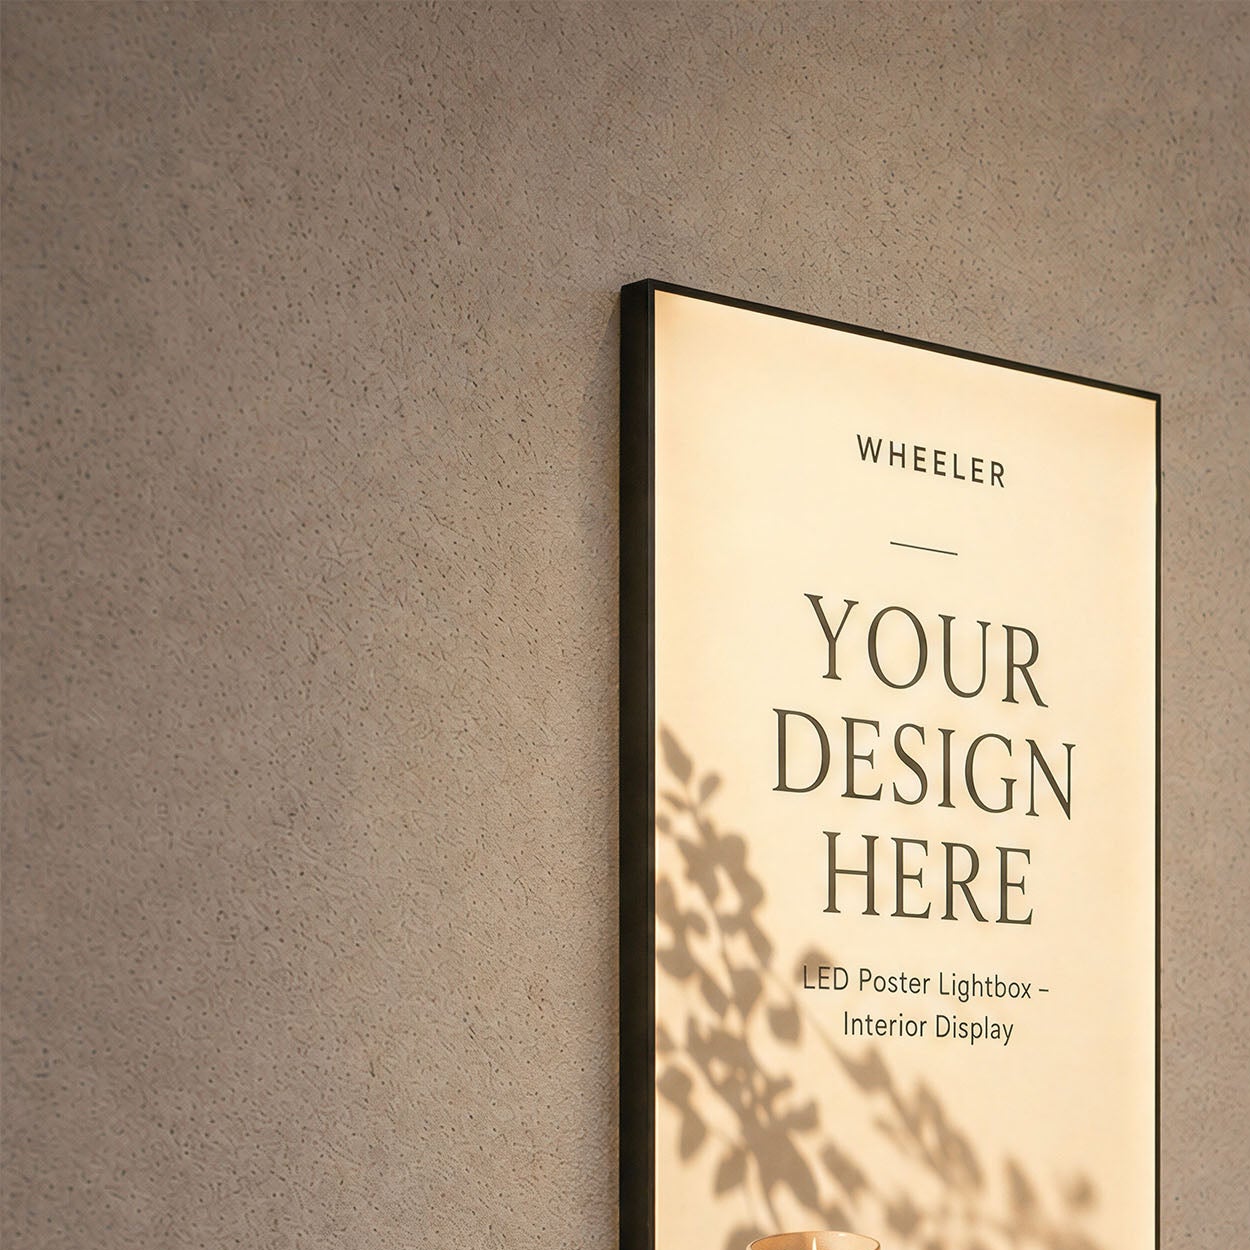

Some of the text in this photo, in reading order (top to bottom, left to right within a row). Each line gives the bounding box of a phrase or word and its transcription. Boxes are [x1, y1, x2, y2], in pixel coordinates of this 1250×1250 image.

[856, 434, 1007, 488] WHEELER
[804, 593, 1049, 708] YOUR
[772, 707, 1077, 822] DESIGN
[821, 831, 1035, 926] HERE
[802, 964, 850, 992] LED
[858, 968, 931, 996] Poster
[938, 970, 1033, 1002] Lightbox
[842, 1011, 1015, 1046] Interior Display
